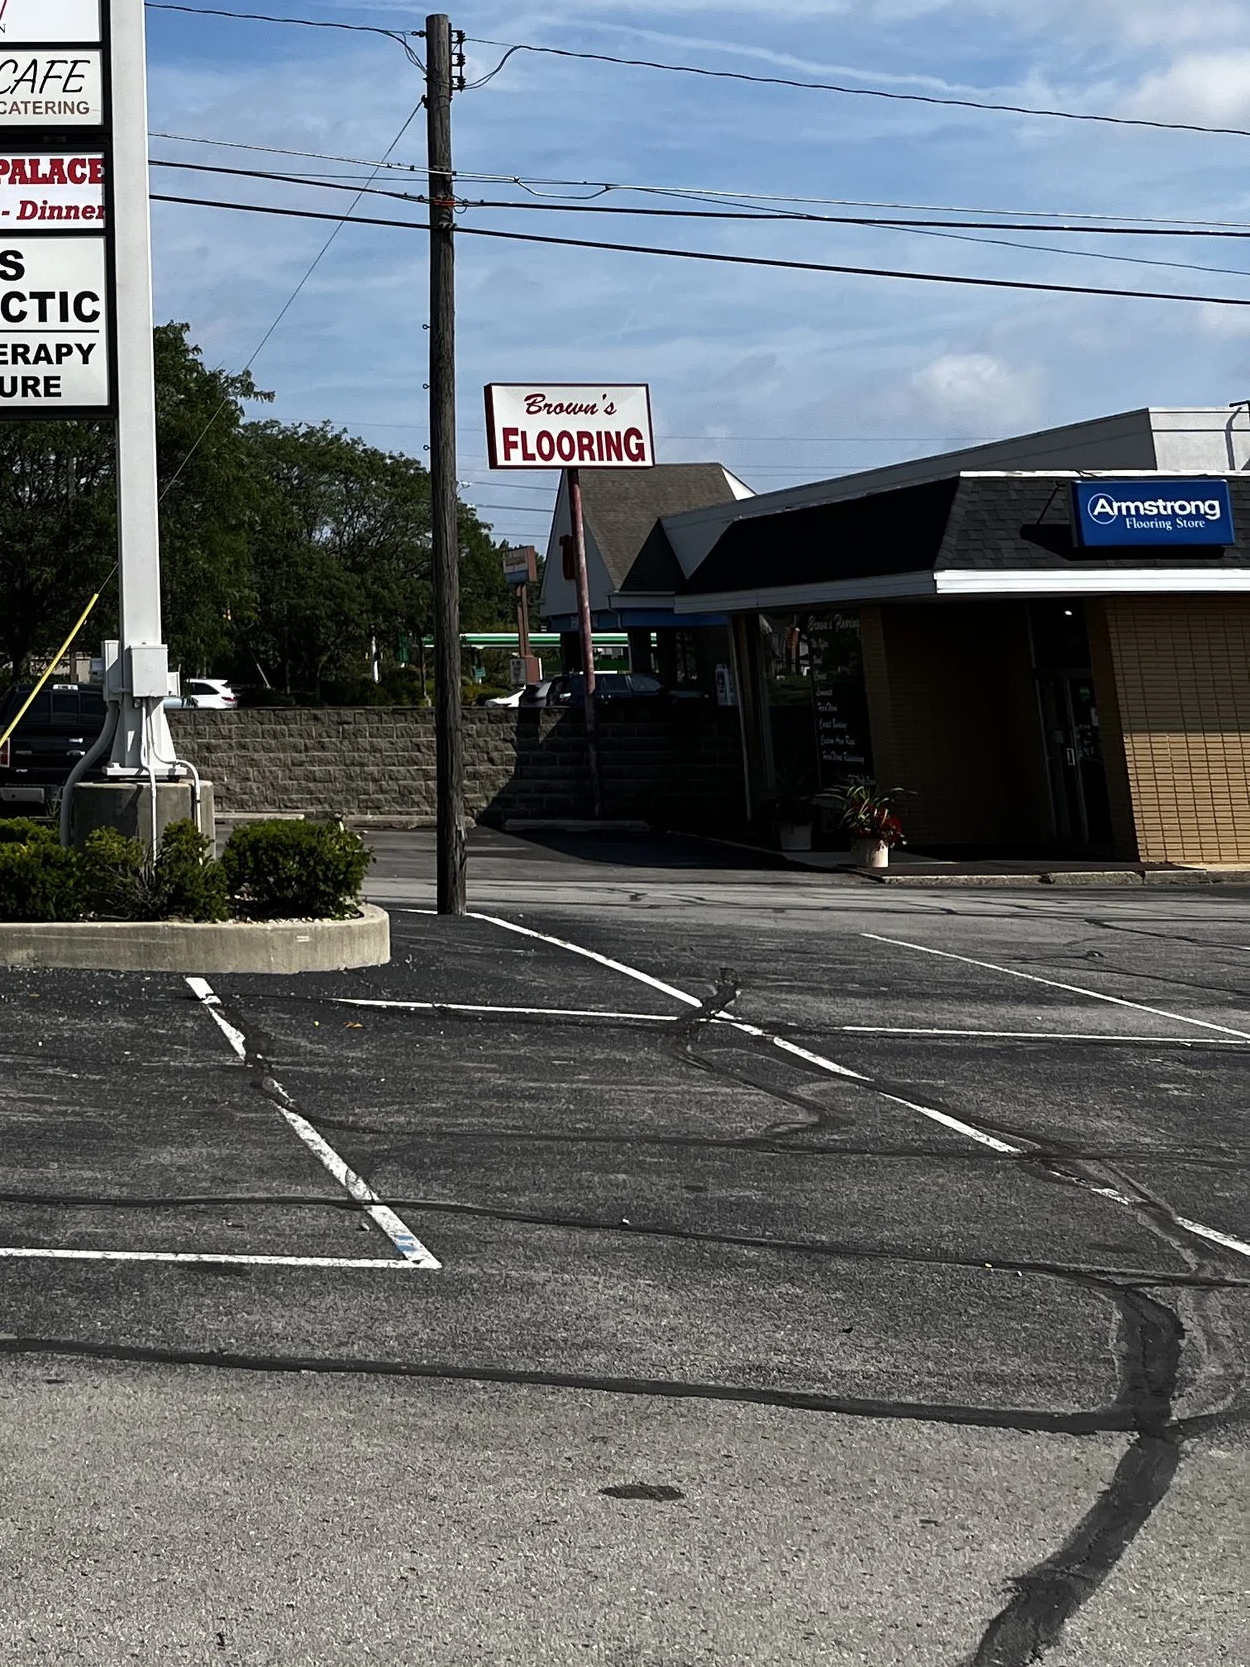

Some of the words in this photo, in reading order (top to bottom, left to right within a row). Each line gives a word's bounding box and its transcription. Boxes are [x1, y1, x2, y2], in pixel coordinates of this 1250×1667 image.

[17, 200, 105, 221] Dinner
[524, 393, 617, 415] Brown's
[502, 427, 646, 462] FLOORING
[1093, 498, 1221, 520] Armstrong
[1125, 518, 1173, 531] Flooring
[1176, 518, 1206, 529] Store
